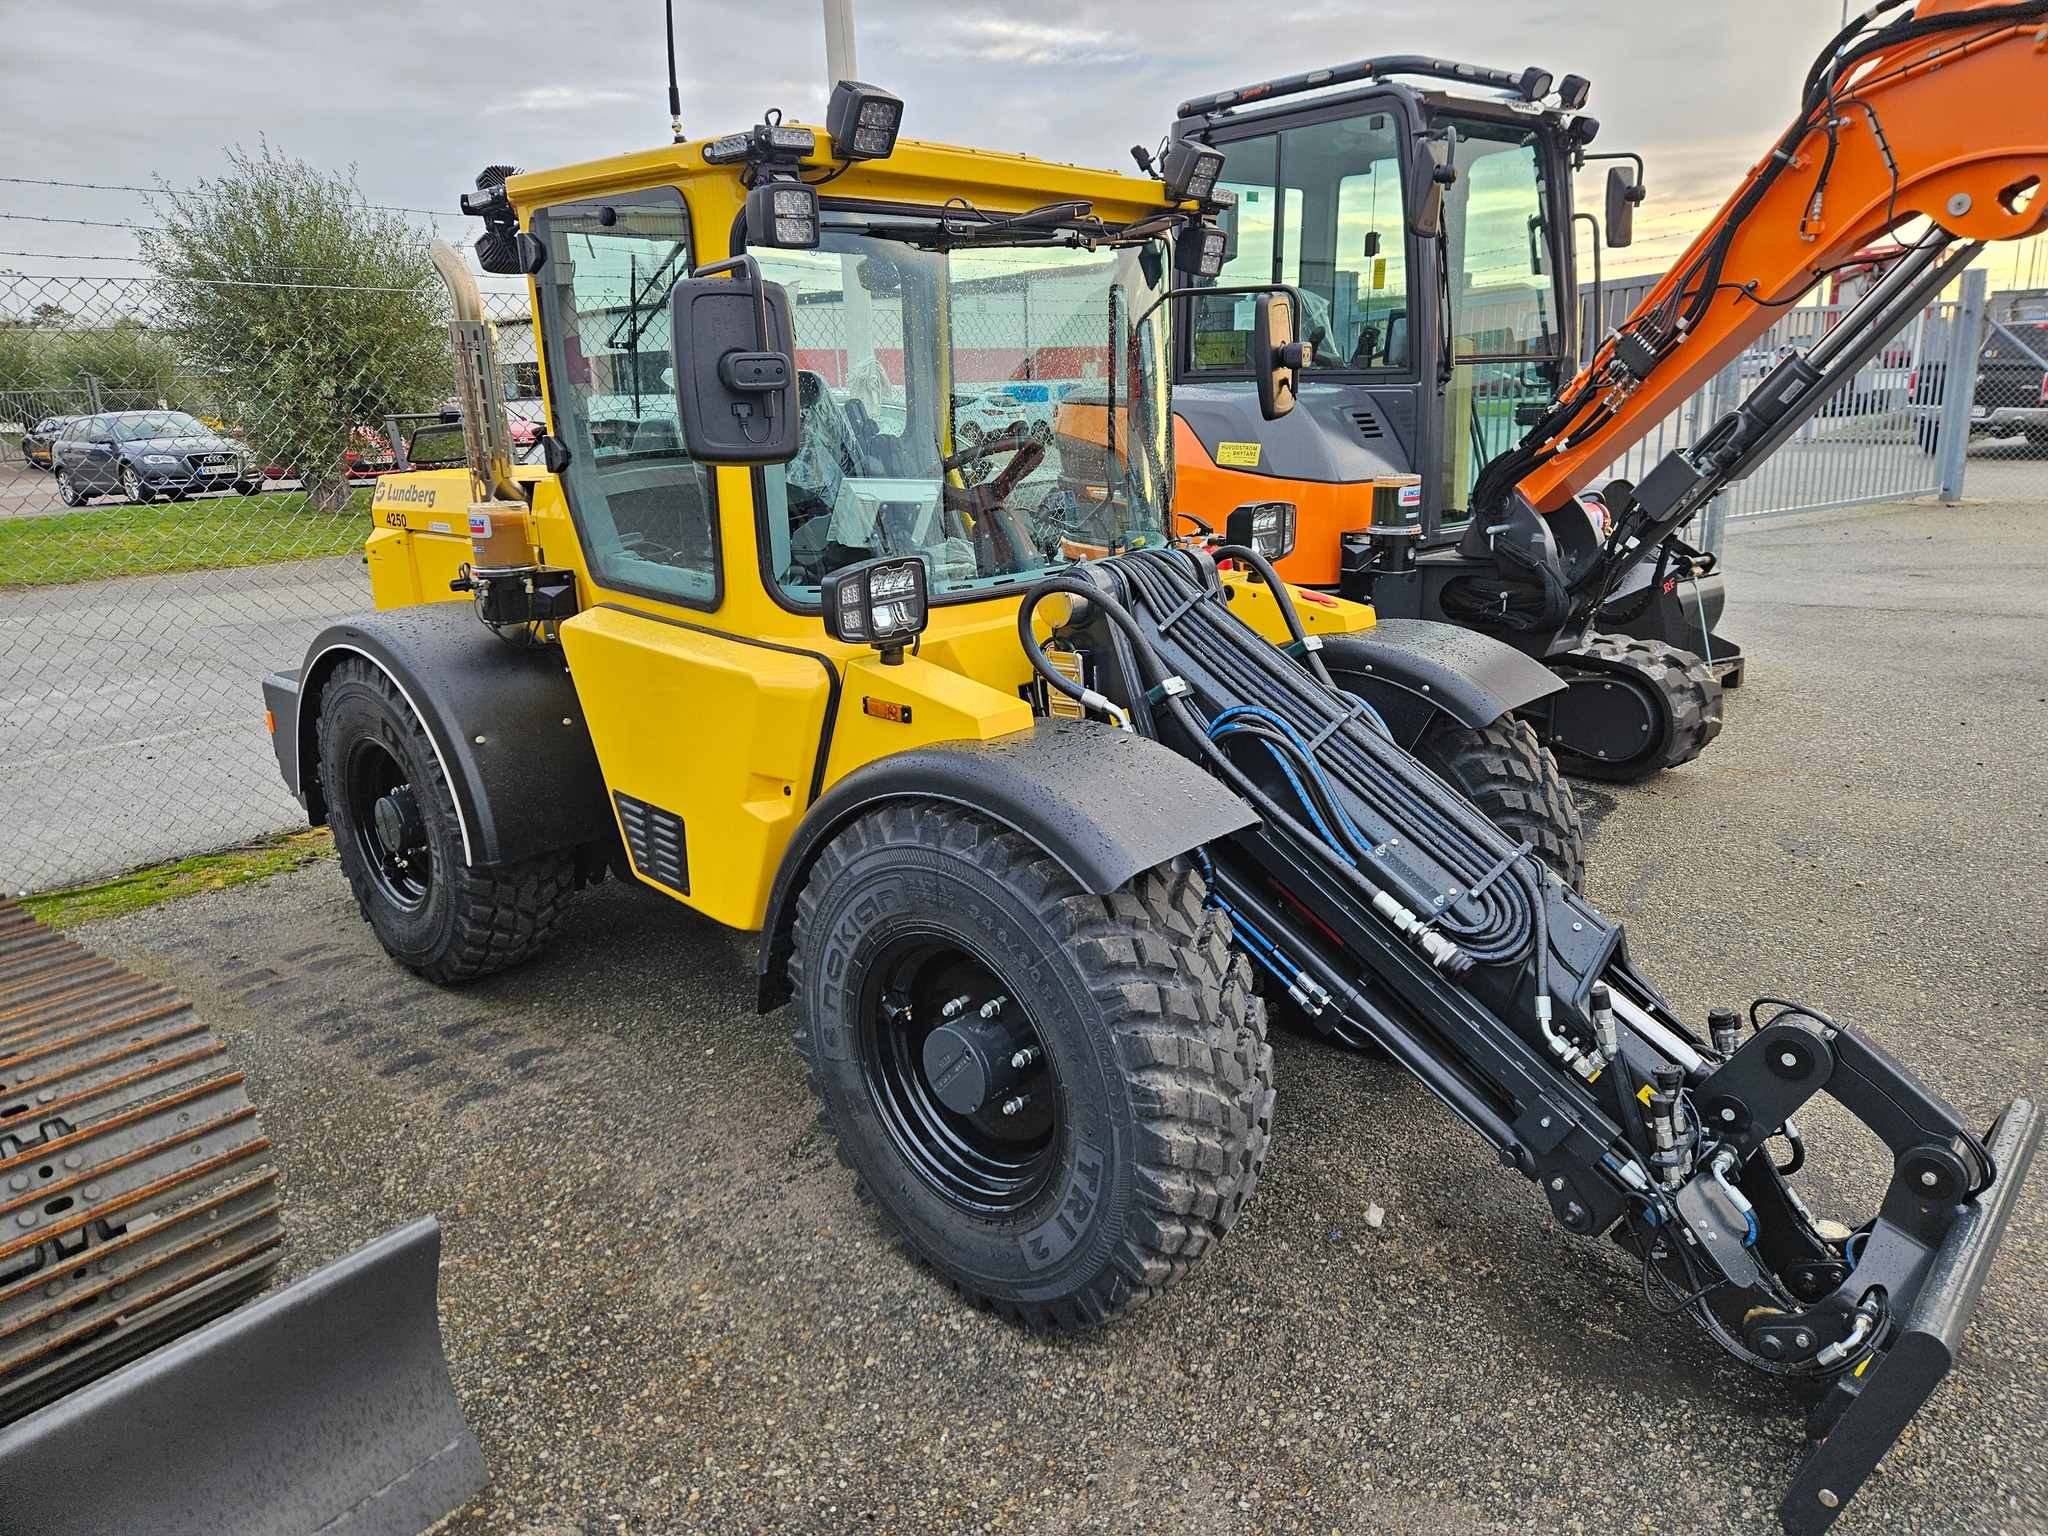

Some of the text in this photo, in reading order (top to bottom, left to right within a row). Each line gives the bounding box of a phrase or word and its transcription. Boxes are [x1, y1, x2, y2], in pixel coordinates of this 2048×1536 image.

[387, 483, 436, 509] Lundberg
[386, 513, 407, 528] 4250
[1028, 1161, 1099, 1260] TRI 2
